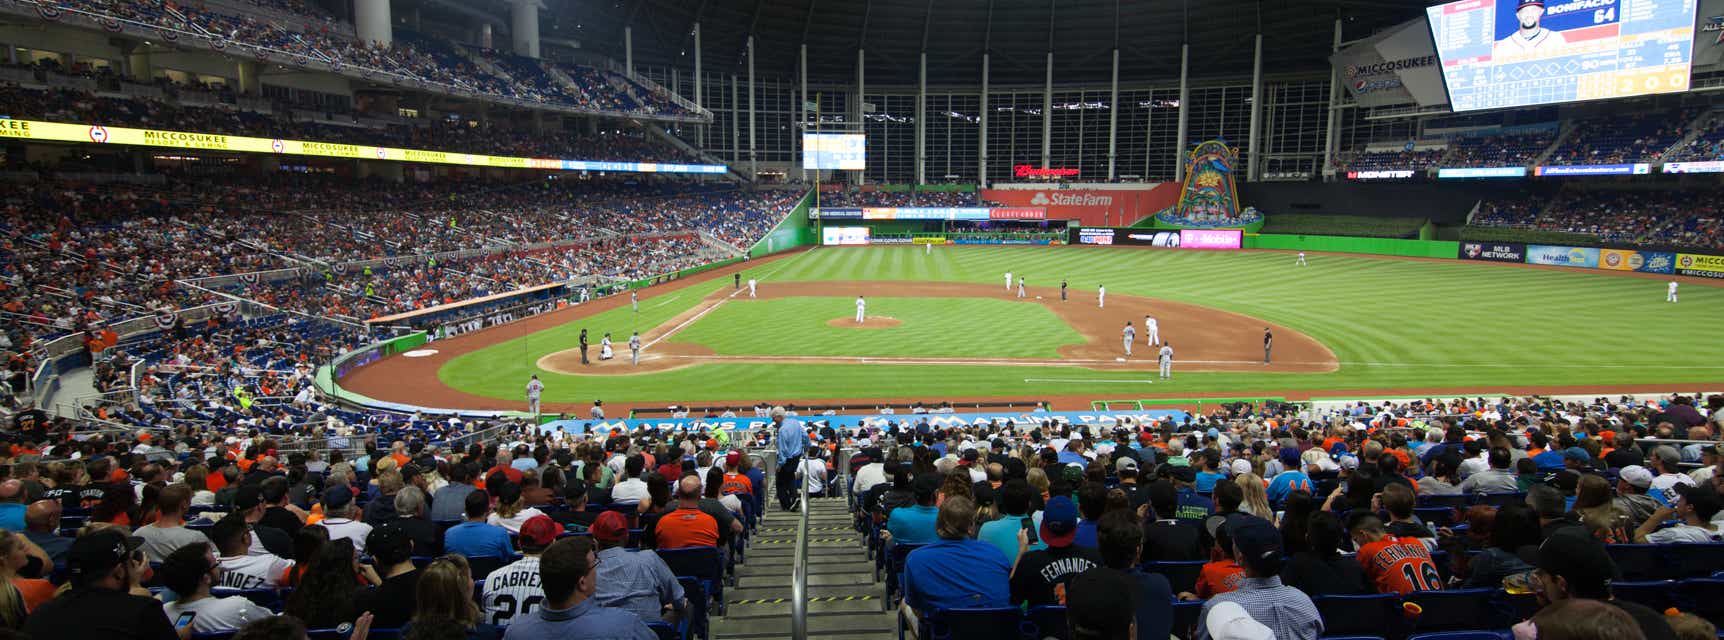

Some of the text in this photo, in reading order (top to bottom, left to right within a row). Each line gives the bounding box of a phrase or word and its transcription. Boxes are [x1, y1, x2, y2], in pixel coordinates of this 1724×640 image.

[1547, 0, 1616, 15] BONIFACIO
[1593, 7, 1615, 24] 64
[1358, 56, 1434, 74] MICCOSUKEE
[144, 131, 228, 143] MICCOSUKEE
[302, 143, 358, 152] MICCOSUKEE
[1014, 165, 1081, 176] Budweiser
[1481, 251, 1519, 259] NETWORK
[493, 571, 542, 591] CABRE
[1402, 562, 1440, 591] 16
